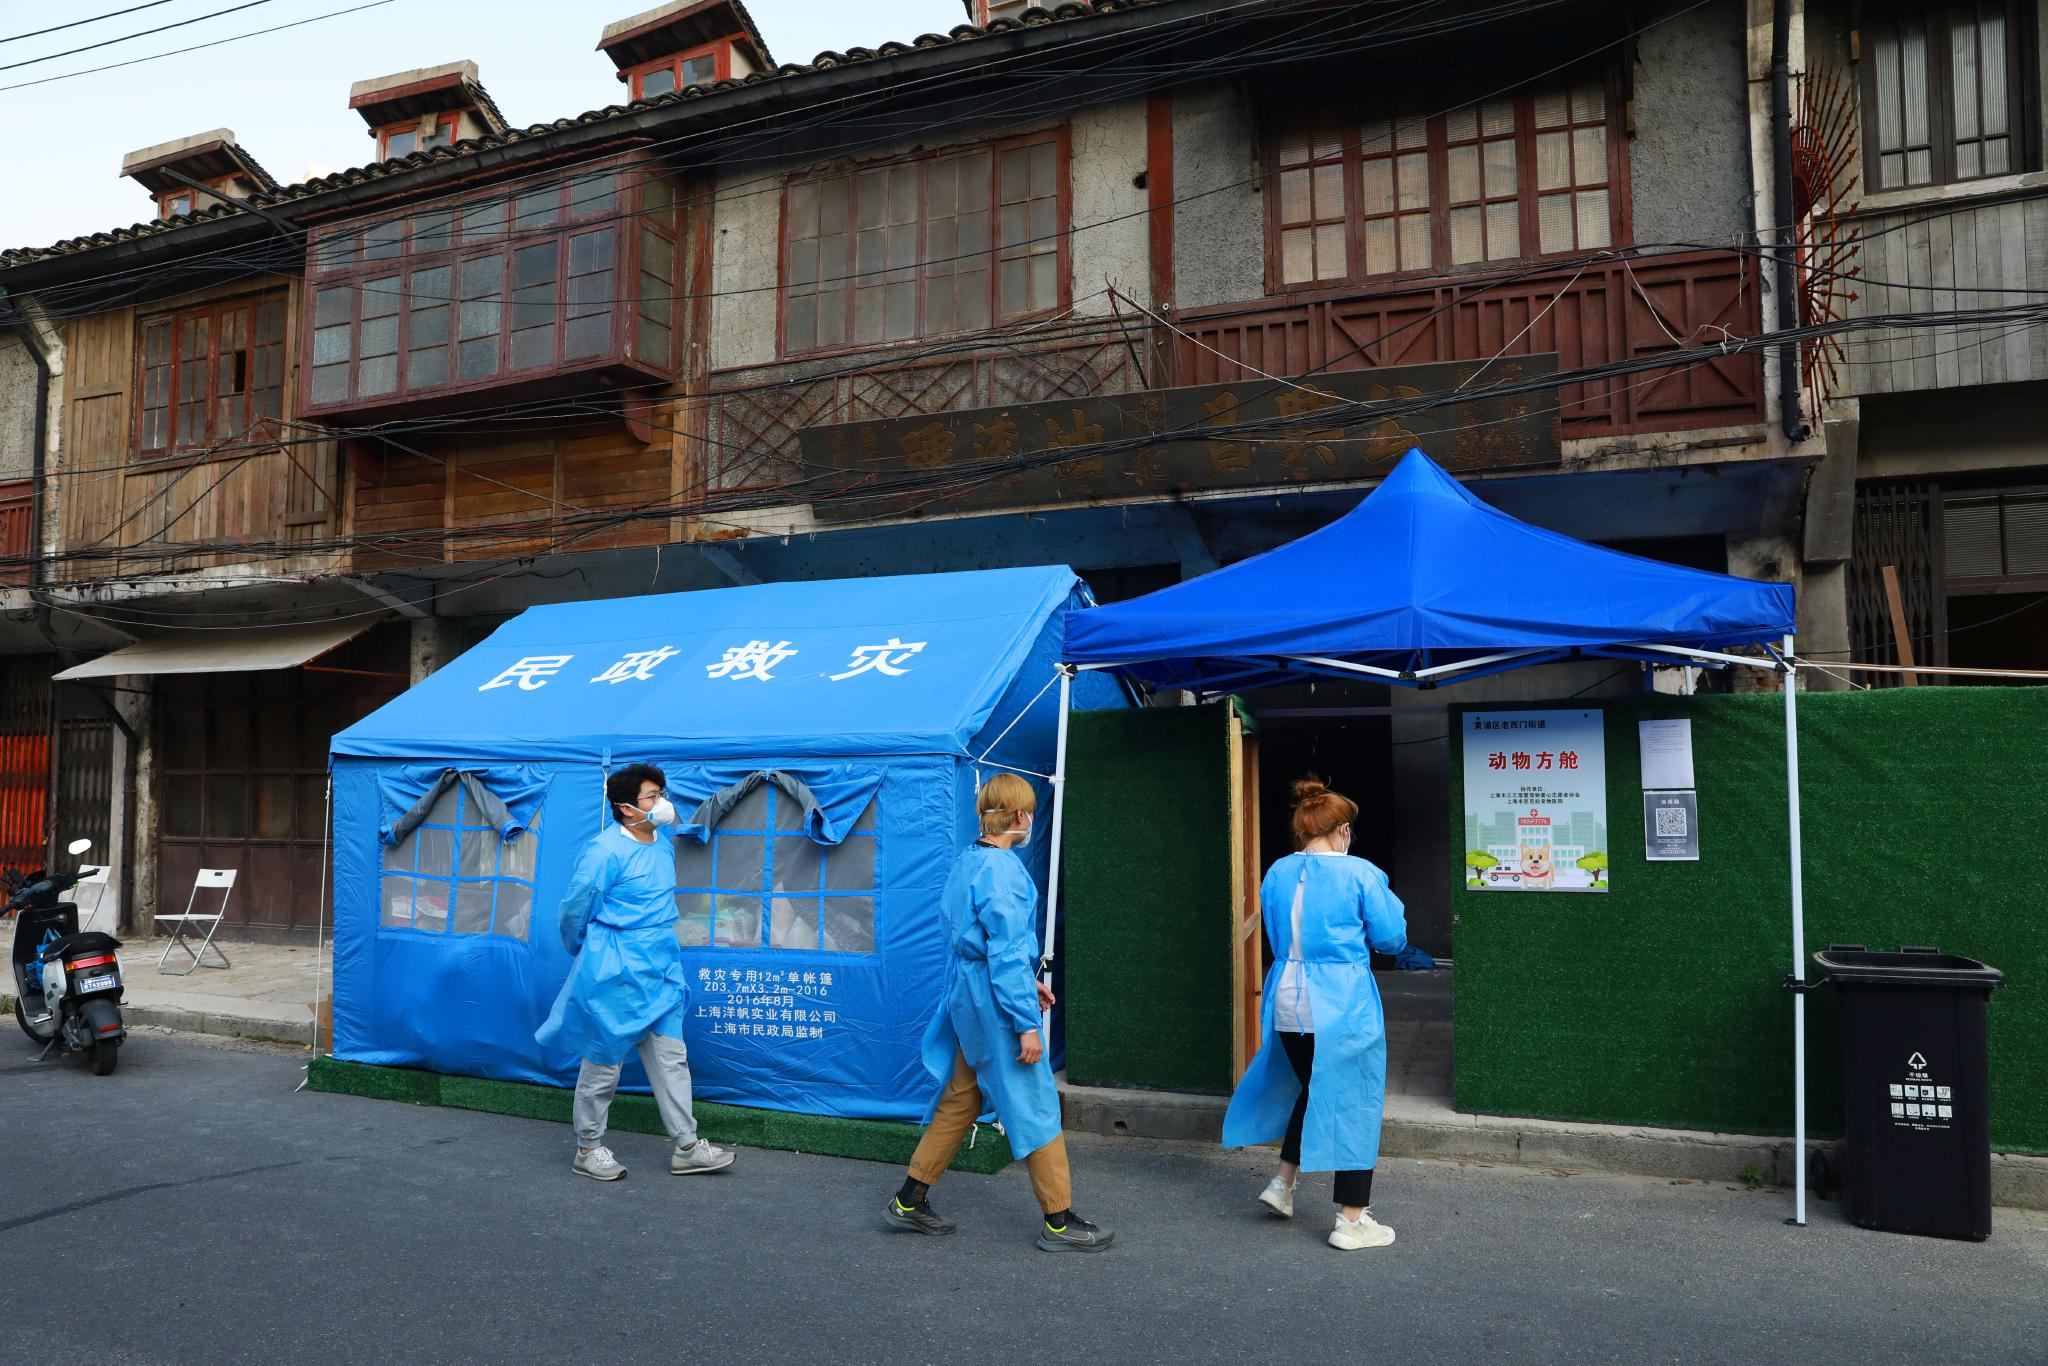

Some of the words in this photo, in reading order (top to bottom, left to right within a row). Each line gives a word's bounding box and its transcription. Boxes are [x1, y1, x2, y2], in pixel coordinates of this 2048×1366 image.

[478, 637, 927, 692] 民政救灾
[1474, 720, 1546, 730] 黄浦区老西门街道
[1488, 750, 1579, 770] 动物方舱
[727, 994, 794, 1008] 2016年8月
[695, 1006, 836, 1023] 上海洋帆实业有限公司
[710, 1022, 823, 1039] 上海市民政局监制
